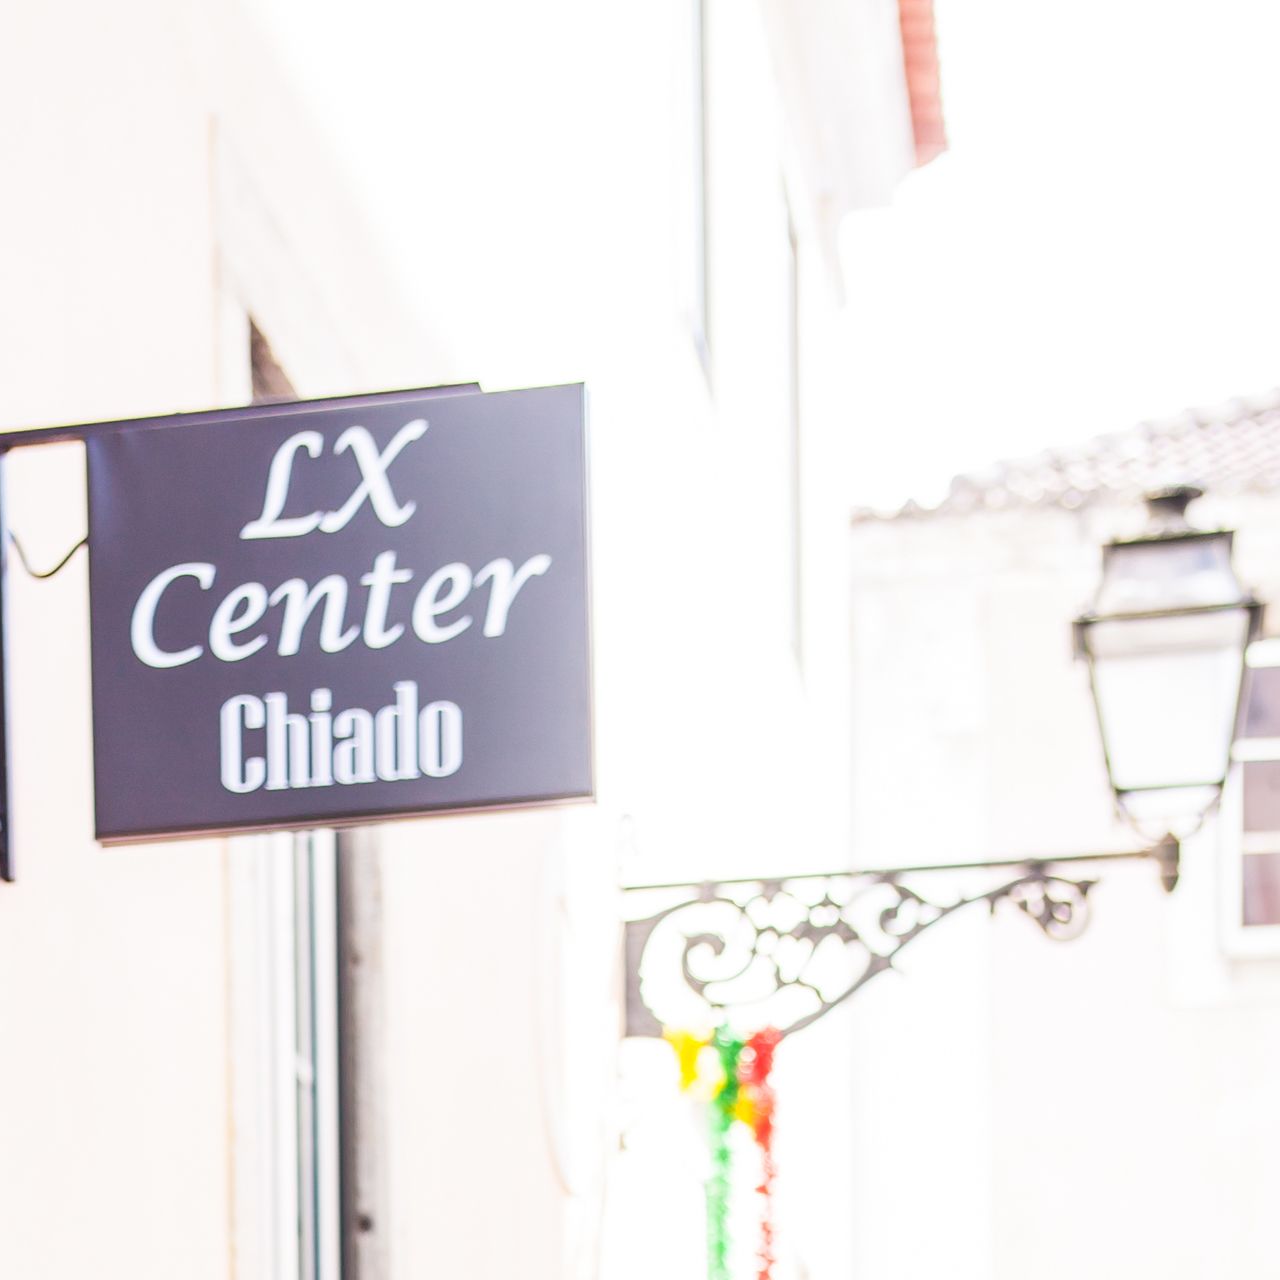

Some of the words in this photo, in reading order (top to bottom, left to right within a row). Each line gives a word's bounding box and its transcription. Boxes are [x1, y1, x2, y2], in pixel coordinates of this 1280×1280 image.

[238, 418, 429, 540] LX
[130, 549, 553, 669] Center
[219, 680, 463, 793] Chiado
